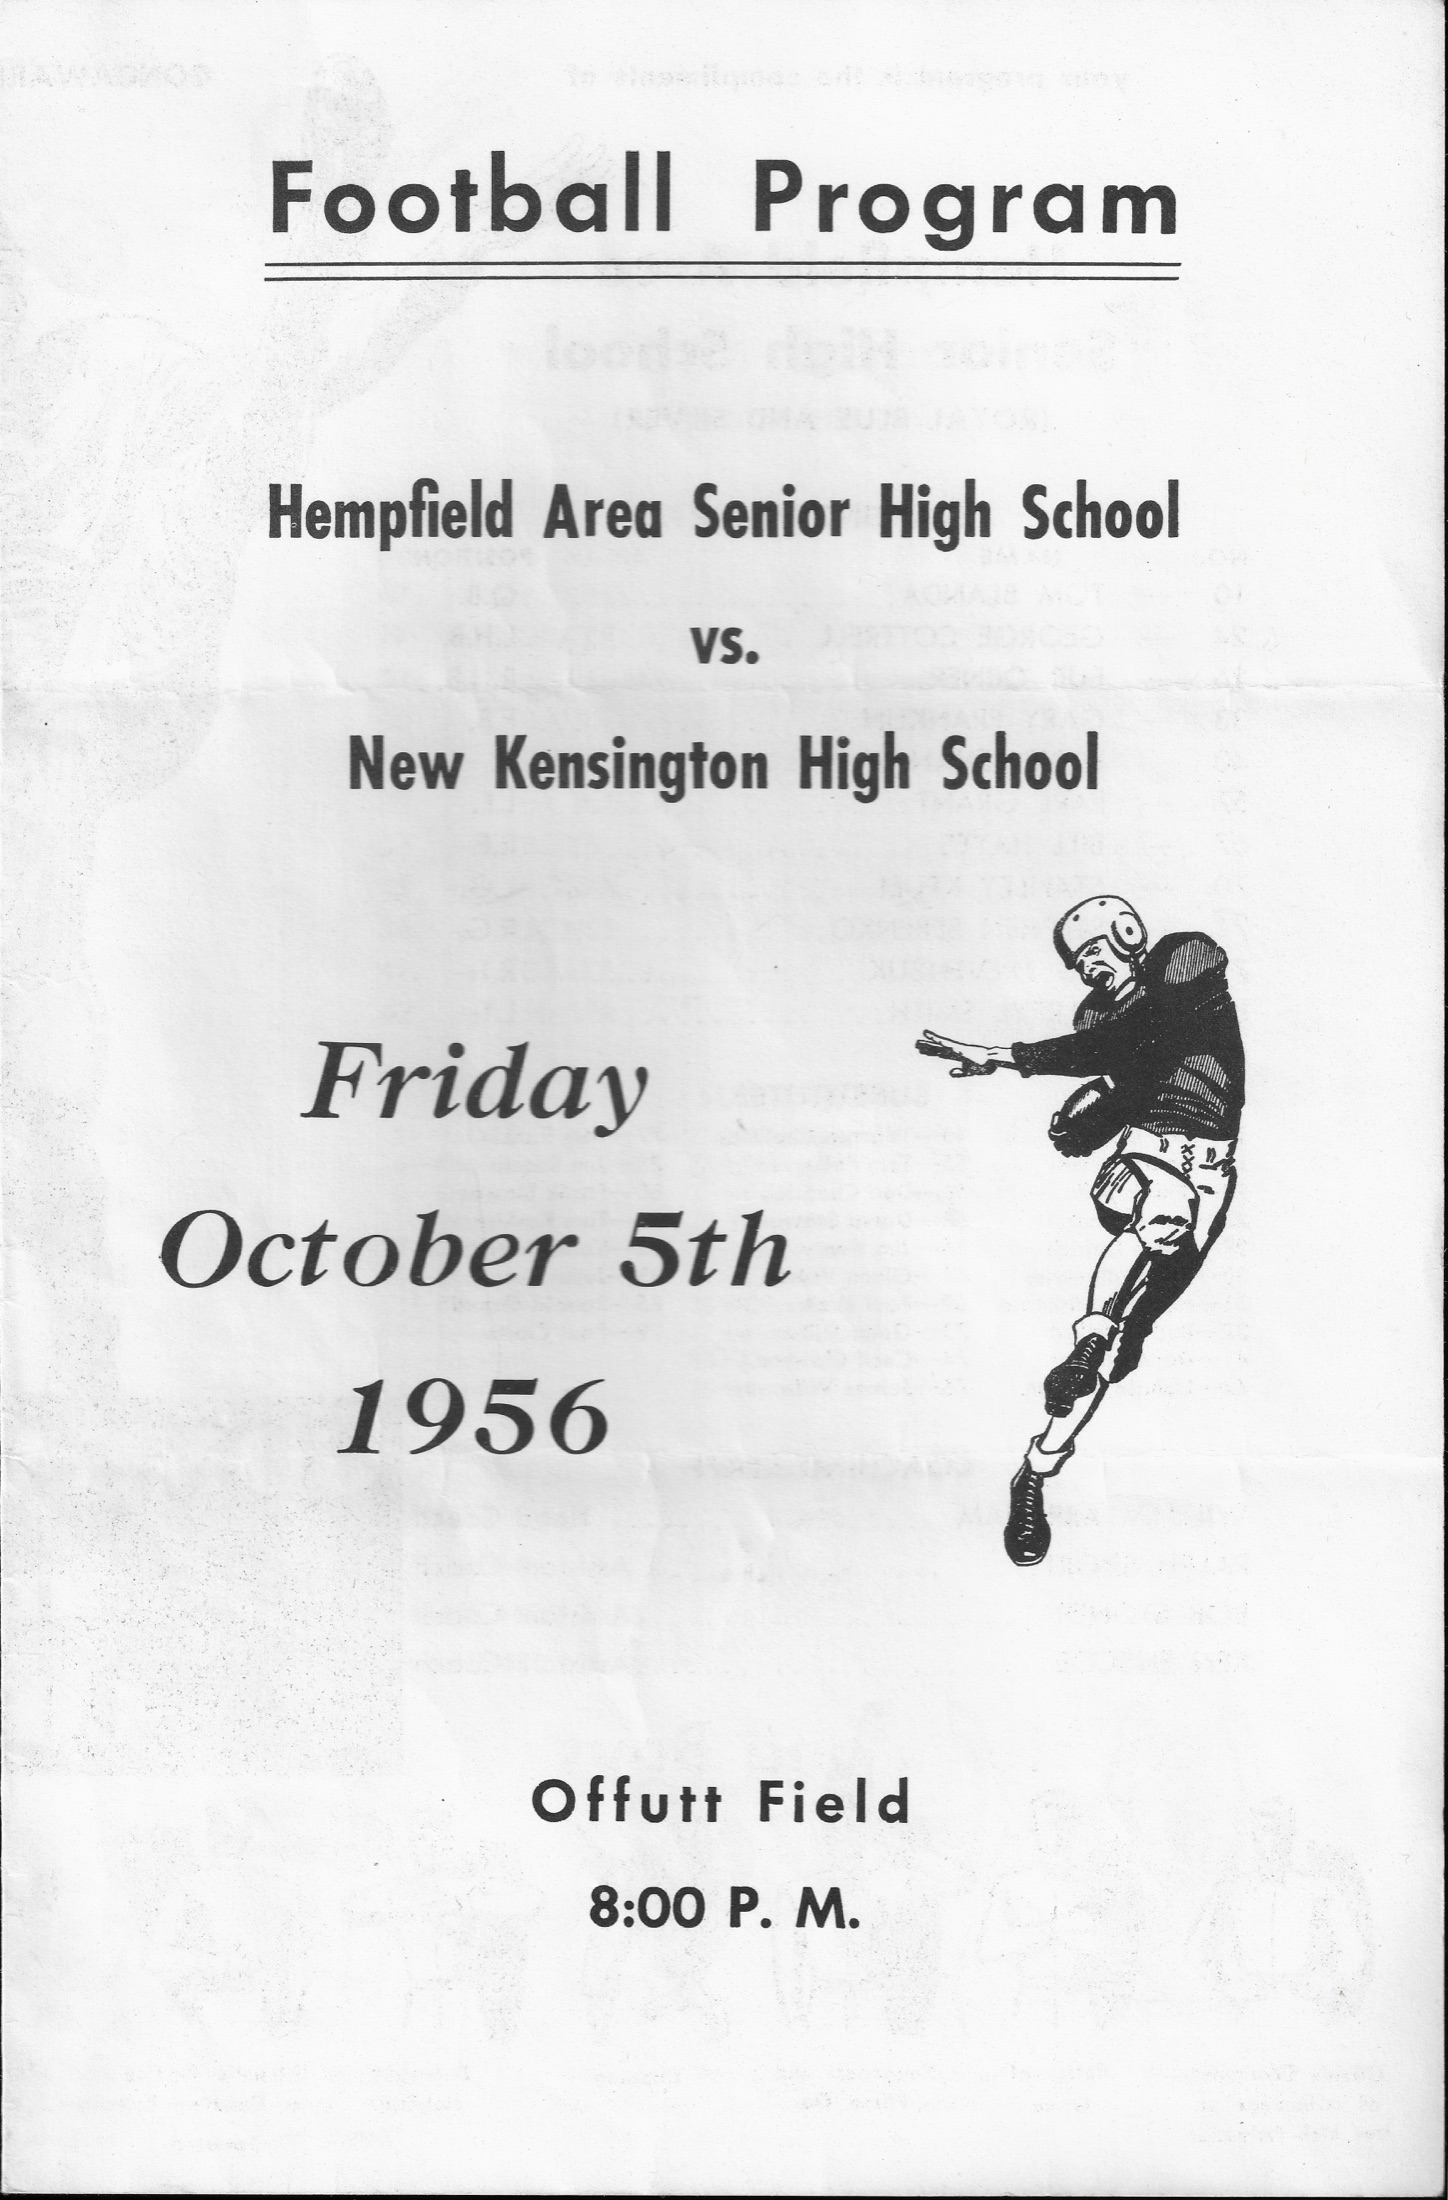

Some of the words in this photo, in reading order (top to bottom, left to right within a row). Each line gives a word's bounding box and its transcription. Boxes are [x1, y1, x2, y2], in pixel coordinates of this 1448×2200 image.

[271, 150, 672, 234] Football
[754, 159, 1178, 252] Program
[268, 477, 513, 552] Hempfield
[543, 483, 662, 539] Area
[694, 482, 850, 539] Senior
[880, 478, 991, 553] High
[1022, 479, 1179, 540] School
[690, 627, 759, 665] vs.
[349, 734, 464, 791] New
[495, 734, 768, 804] Kensington
[800, 730, 910, 804] High
[942, 730, 1098, 790] School
[300, 1041, 648, 1138] Friday
[158, 1209, 579, 1289] October
[620, 1209, 791, 1288] 5th
[336, 1377, 608, 1455] 1956
[531, 1774, 722, 1824] Offutt
[759, 1776, 908, 1824] Field
[589, 1884, 706, 1929] 8:00
[729, 1885, 772, 1929] P.
[796, 1885, 860, 1929] M.
